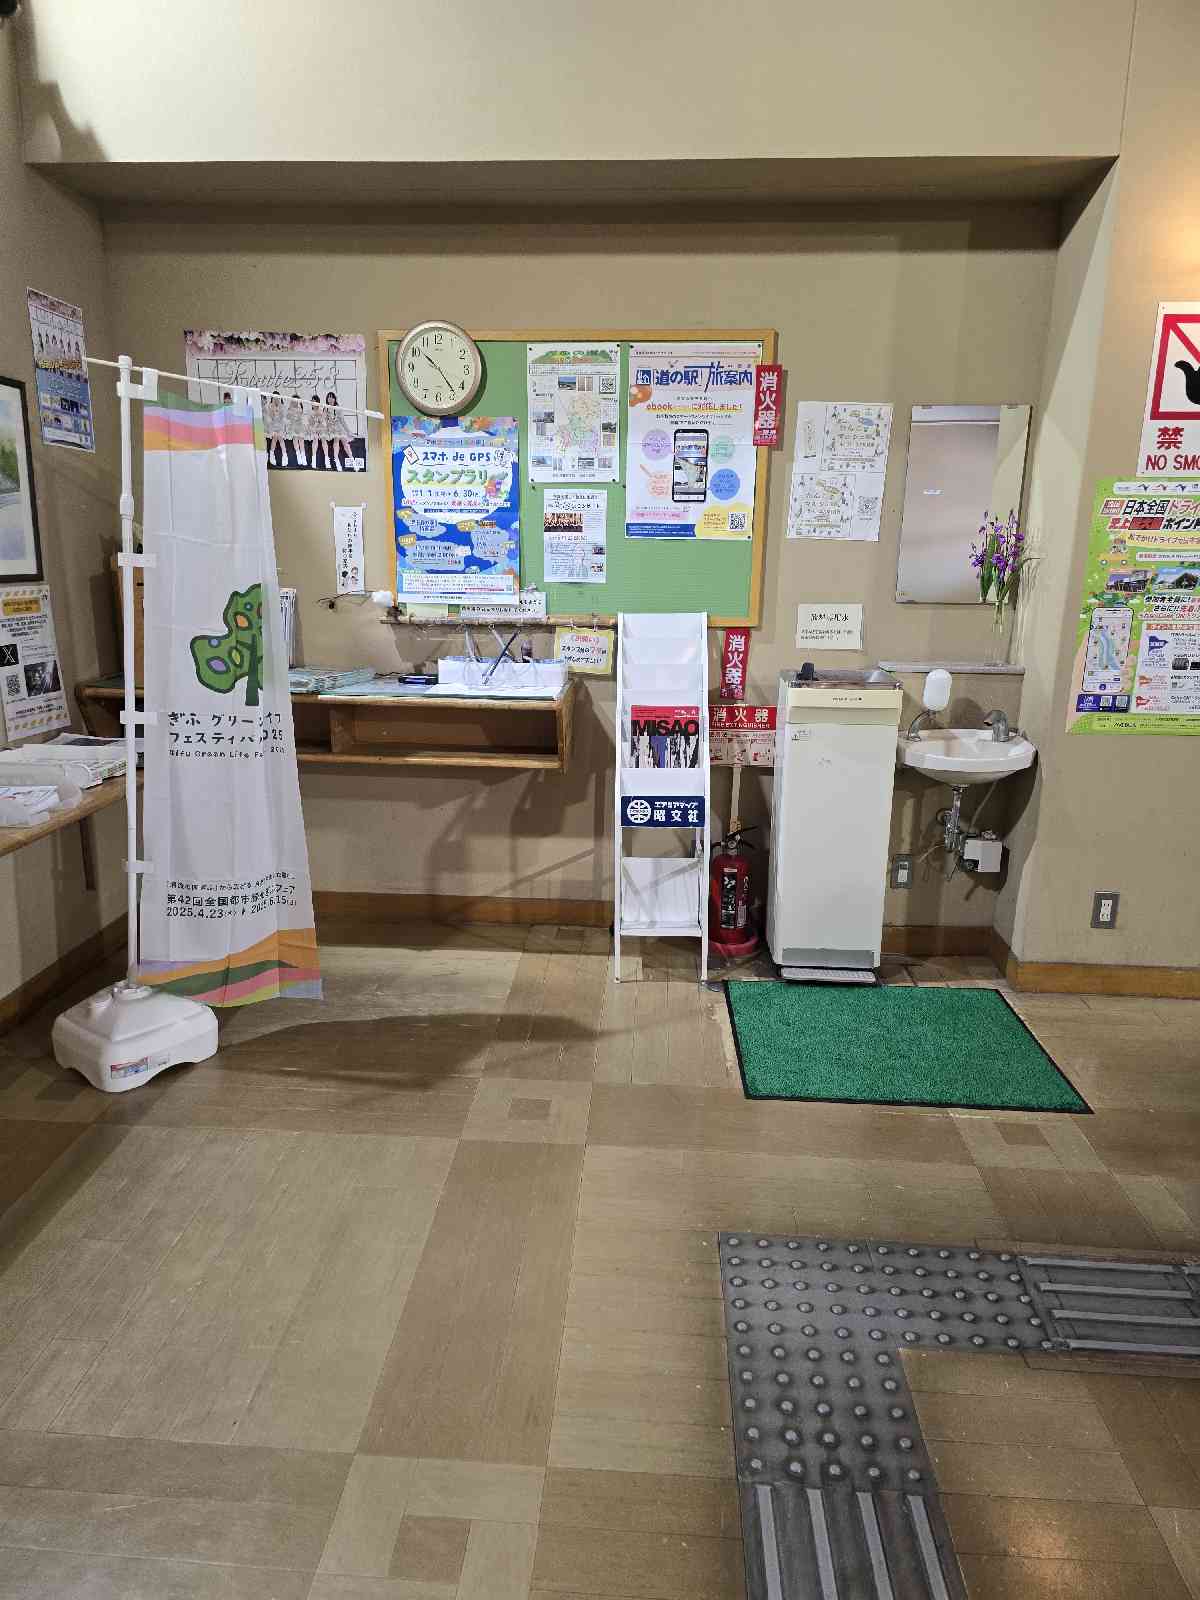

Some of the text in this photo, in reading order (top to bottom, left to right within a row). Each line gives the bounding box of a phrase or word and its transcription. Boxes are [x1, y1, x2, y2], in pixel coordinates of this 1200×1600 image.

[434, 333, 443, 345] 12
[411, 346, 421, 358] 10
[458, 348, 466, 361] 2
[463, 364, 470, 376] 3
[458, 380, 465, 391] 4
[758, 371, 778, 429] 消火器
[423, 452, 491, 461] スマホ de GPS
[1145, 455, 1168, 470] NO
[406, 469, 508, 484] スタンプラリー
[726, 634, 746, 684] 消火器
[168, 712, 200, 726] ぎふ
[713, 707, 769, 722] 消火器
[631, 720, 699, 737] MISAO
[653, 810, 699, 823] 昭文社
